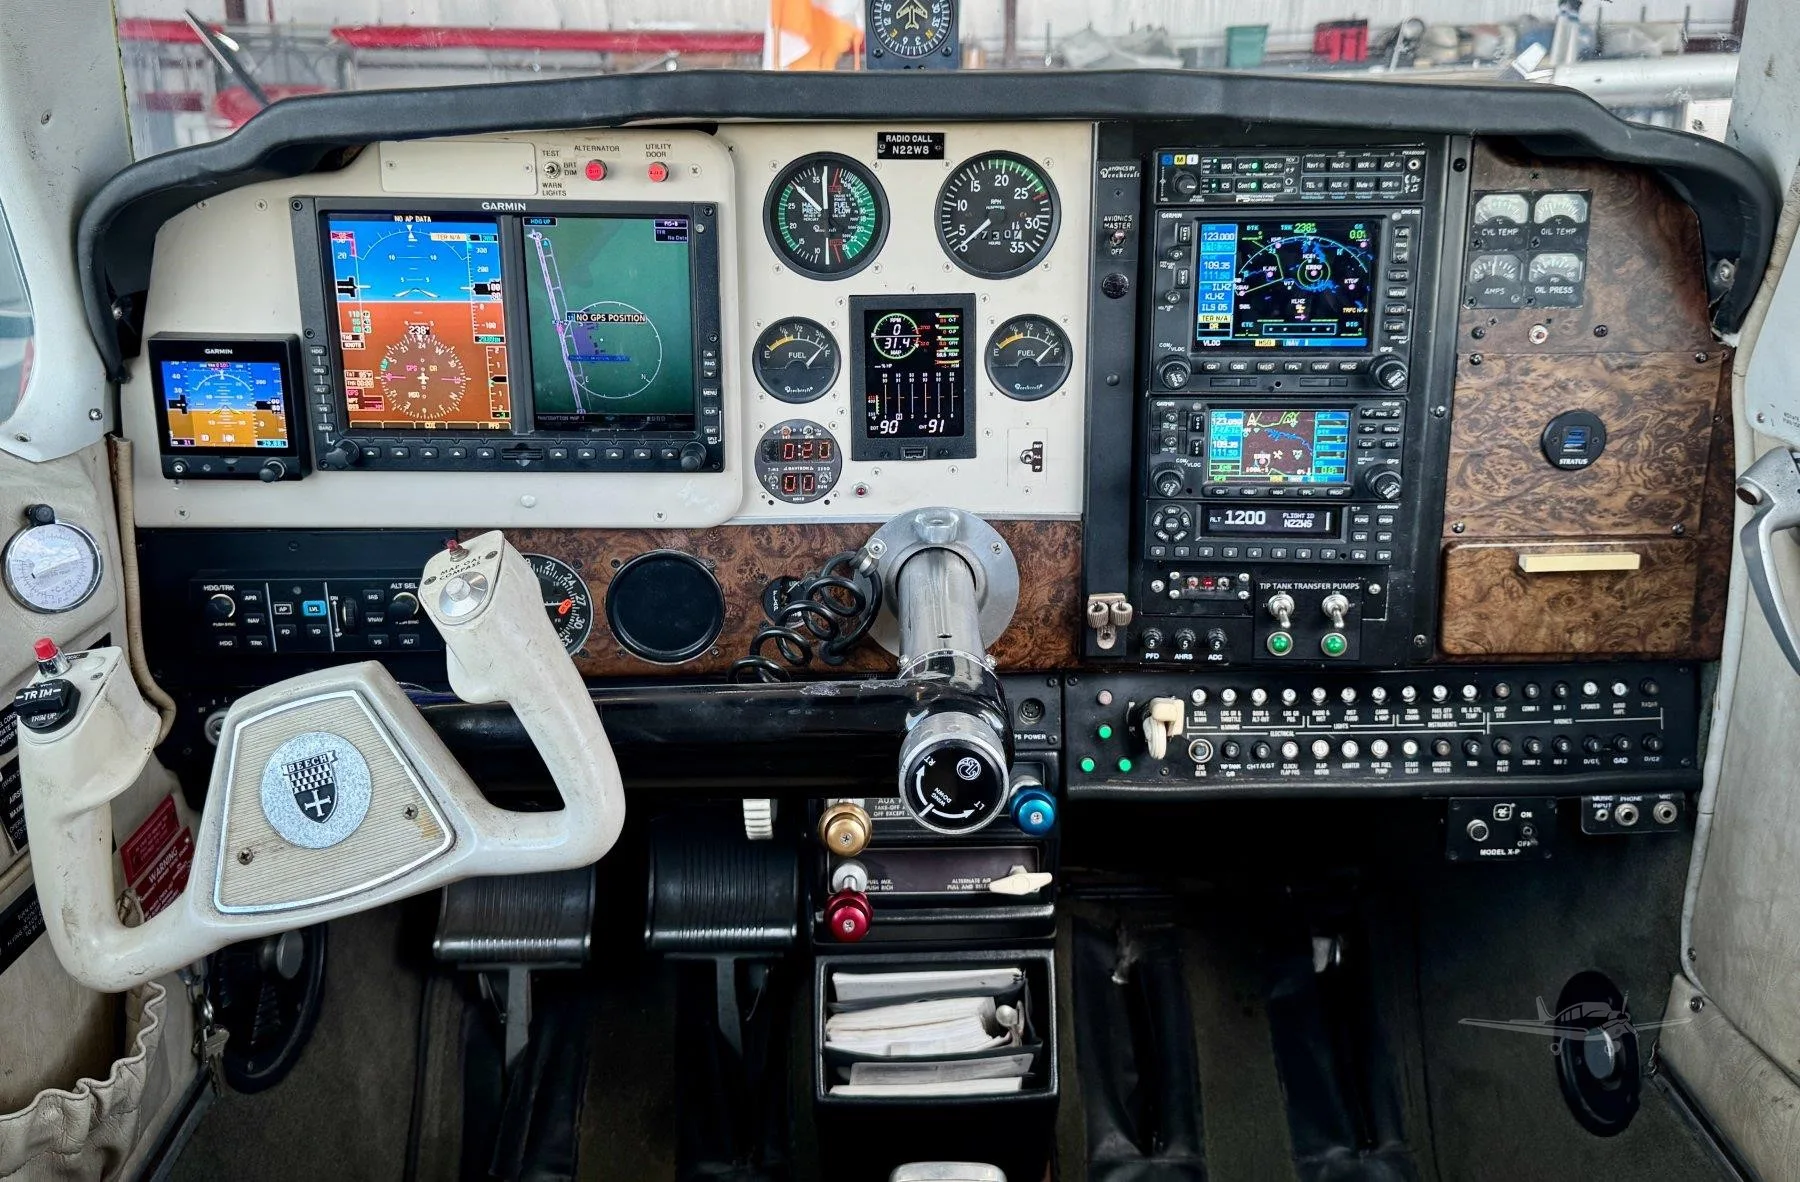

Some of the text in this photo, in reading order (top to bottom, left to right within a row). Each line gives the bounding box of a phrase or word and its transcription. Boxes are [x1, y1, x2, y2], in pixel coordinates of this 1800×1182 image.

[885, 135, 933, 143] RADIO CALL
[574, 144, 620, 152] ALTERNATOR
[1100, 167, 1140, 179] Beechcraft
[994, 174, 1009, 186] 20
[970, 181, 981, 192] 15
[1013, 187, 1029, 200] 25
[481, 202, 526, 212] GARMIN
[787, 202, 796, 210] 25
[957, 200, 968, 211] 10
[789, 222, 797, 230] 20
[1024, 217, 1040, 229] 30
[1103, 222, 1132, 230] MASTER
[958, 224, 966, 236] 5
[1481, 228, 1519, 236] CYL TEMP
[1203, 232, 1235, 240] 123.000
[1009, 241, 1025, 253] 35
[1203, 261, 1230, 270] 109.35
[1212, 283, 1232, 291] ILHZ
[1534, 286, 1573, 294] OIL PRESS
[1201, 303, 1228, 311] ILS 05
[576, 313, 646, 323] NO GPS POSITION
[794, 324, 803, 332] 1/2
[893, 323, 901, 336] 0
[1024, 321, 1034, 331] 1/2
[884, 337, 911, 349] 31.4
[764, 350, 771, 359] E
[993, 348, 1000, 356] E
[1053, 348, 1060, 356] F
[879, 419, 899, 434] 90
[928, 419, 945, 433] 91
[1224, 510, 1266, 525] 1200
[1284, 520, 1313, 528] N22WS
[439, 561, 481, 581] COMPASS
[544, 561, 554, 571] 21
[563, 573, 576, 586] 24
[203, 584, 235, 592] HDG/TRK
[1259, 582, 1271, 590] TIP
[575, 594, 586, 606] 27
[574, 616, 586, 630] 30
[1149, 639, 1155, 647] 5
[1183, 640, 1189, 648] 5
[1214, 641, 1220, 649] 5
[1145, 652, 1160, 660] PFD
[24, 688, 53, 701] TRIM
[1560, 687, 1566, 695] 5
[46, 712, 57, 720] UP
[1533, 743, 1539, 751] 5
[287, 754, 328, 773] BEECH
[923, 755, 937, 766] RT
[1246, 762, 1275, 770] CHT/EGT
[931, 792, 946, 807] WING
[934, 787, 952, 804] DOWN
[973, 801, 986, 811] LT
[148, 846, 179, 883] WARNING
